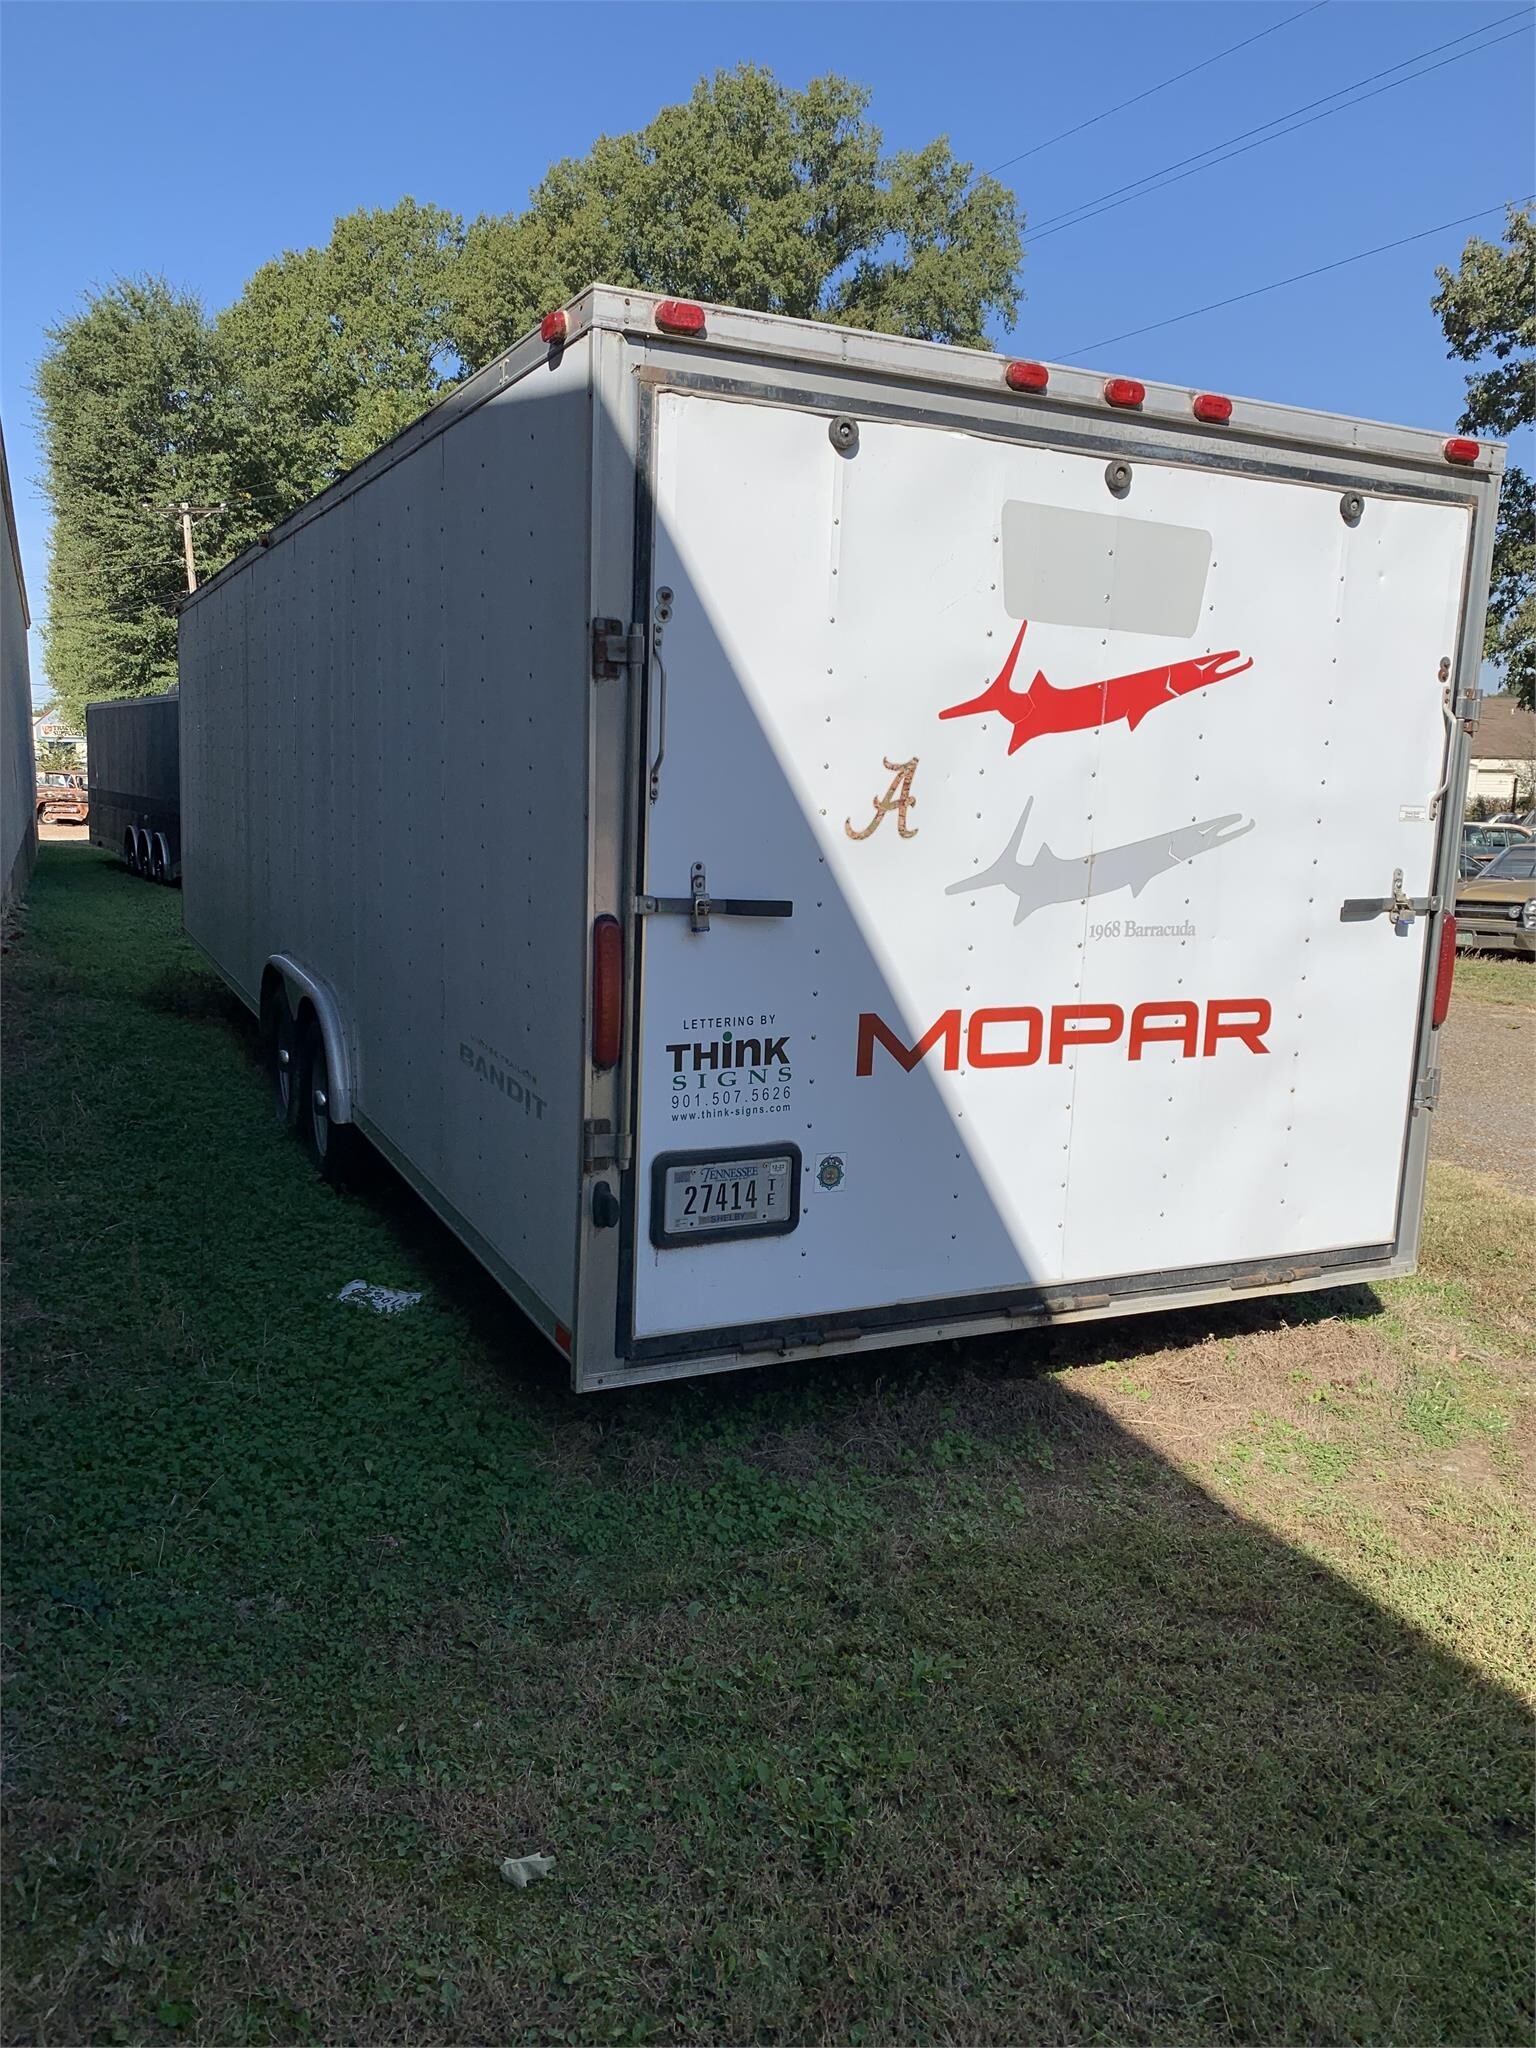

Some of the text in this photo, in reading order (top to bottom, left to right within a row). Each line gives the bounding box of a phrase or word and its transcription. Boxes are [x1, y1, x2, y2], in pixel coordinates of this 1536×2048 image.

[845, 756, 919, 840] A
[1089, 919, 1196, 941] 1968 Barracuda
[683, 1014, 776, 1030] LETTERING BY
[856, 998, 1271, 1077] MOPAR
[460, 1042, 547, 1120] BANDIT
[672, 1066, 793, 1091] SIGNS
[671, 1086, 791, 1109] 901.507.5626
[671, 1103, 791, 1122] www.think-signs.com
[701, 1167, 759, 1183] TENNESSEE
[683, 1180, 758, 1215] 27414
[710, 1213, 745, 1224] SHELBY
